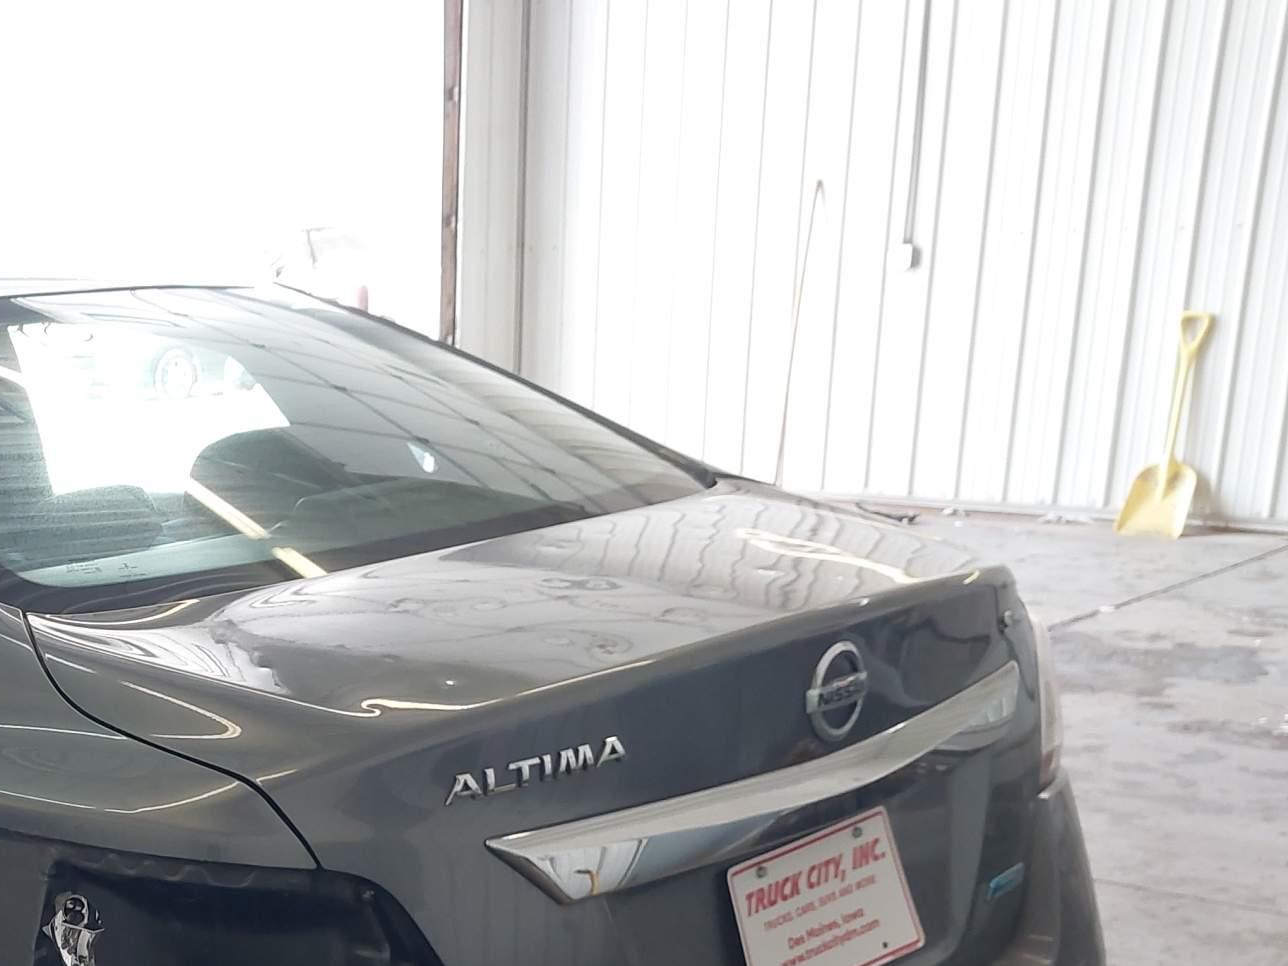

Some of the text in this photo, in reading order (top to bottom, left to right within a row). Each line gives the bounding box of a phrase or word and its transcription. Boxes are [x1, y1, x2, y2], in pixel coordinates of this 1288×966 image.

[445, 736, 626, 806] ALTIMA
[744, 838, 886, 917] TRUCK CITY, INC.
